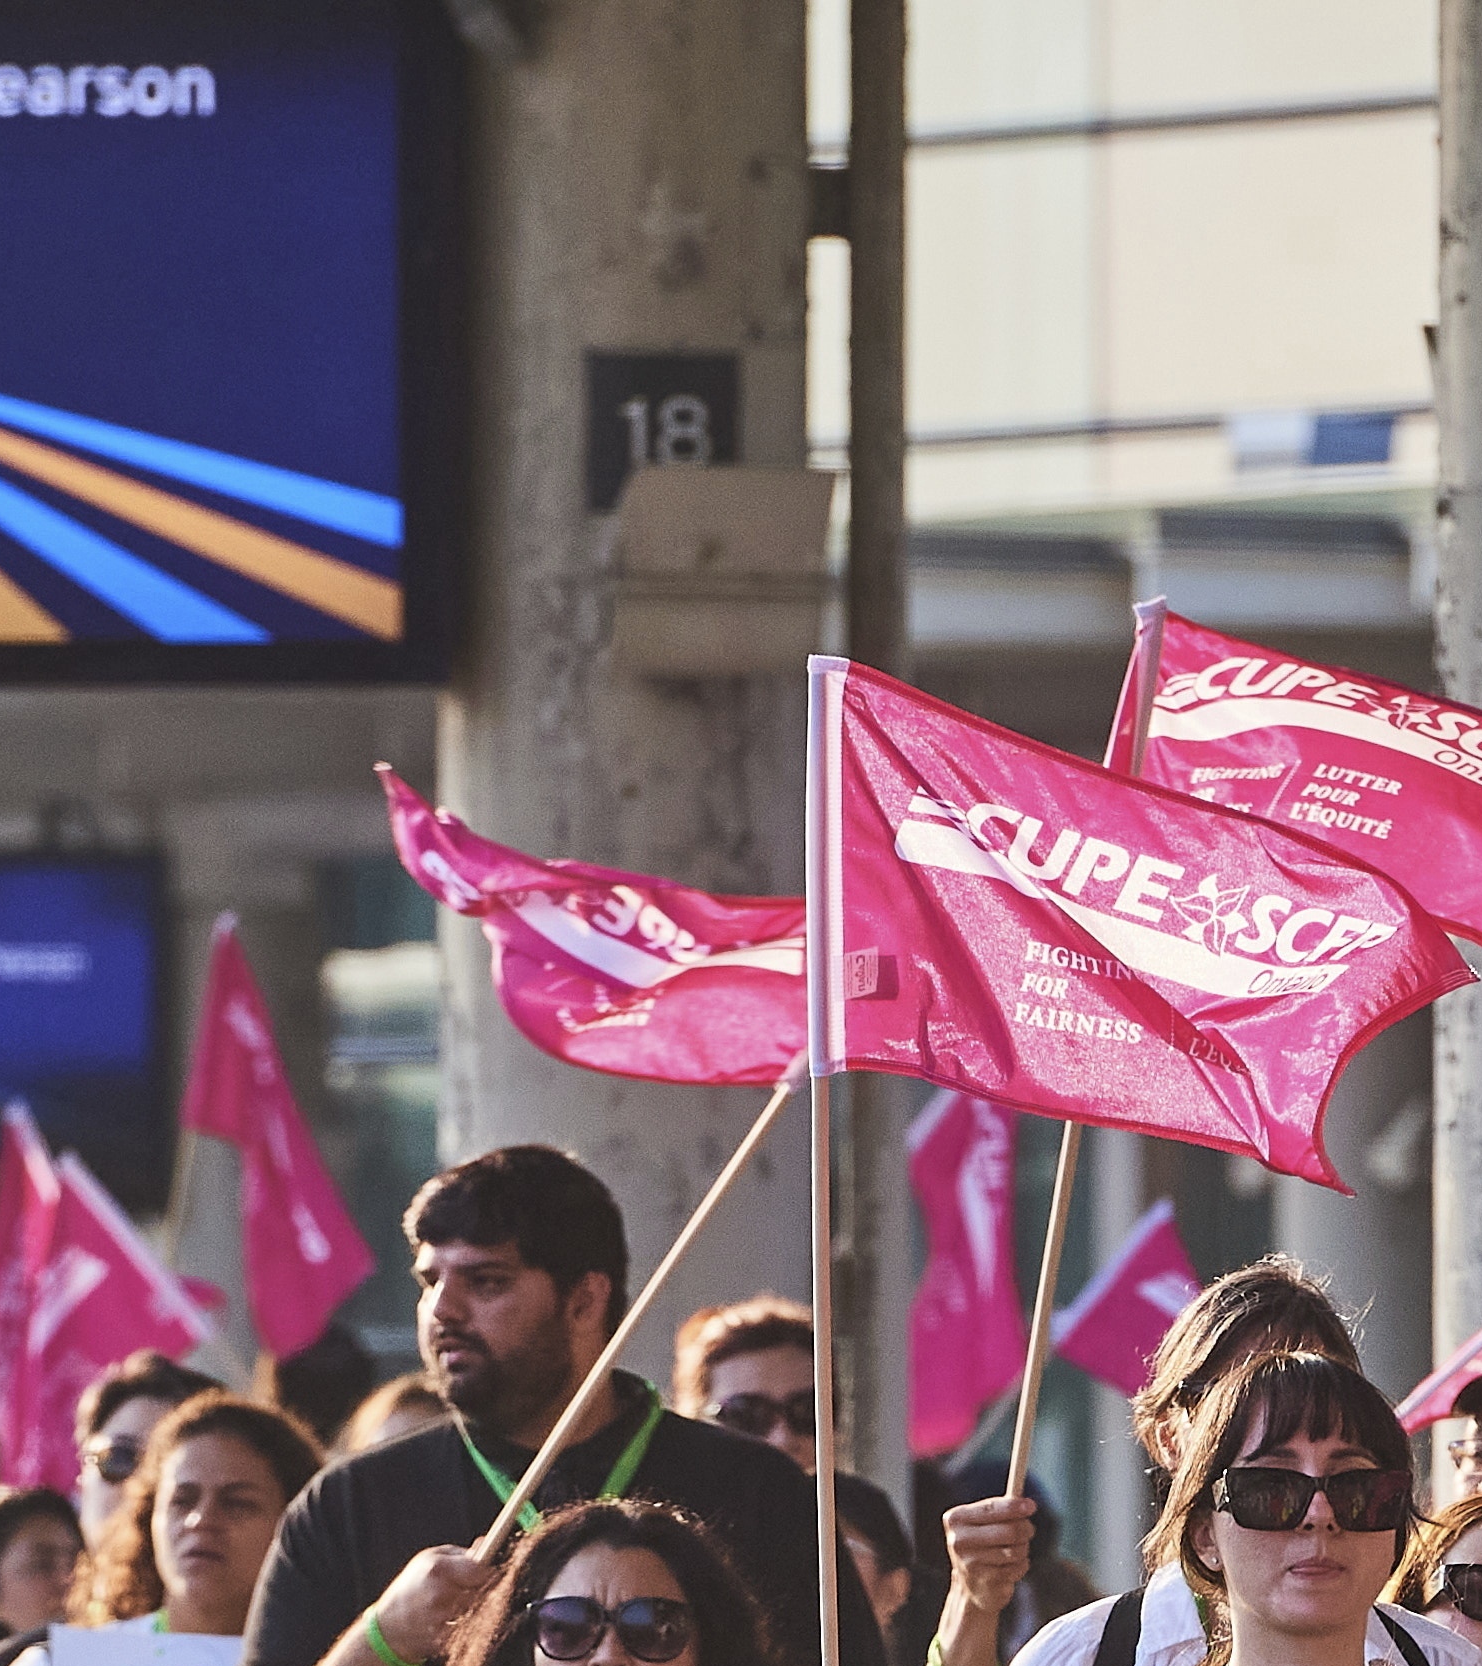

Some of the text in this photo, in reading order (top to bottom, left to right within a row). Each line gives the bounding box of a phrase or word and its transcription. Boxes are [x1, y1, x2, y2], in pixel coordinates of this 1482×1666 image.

[620, 395, 712, 466] 18
[1193, 656, 1377, 710] CUPE
[1189, 762, 1287, 785] FIGHTING
[1312, 762, 1404, 797] LUTTER
[1299, 781, 1362, 808] POUR
[1287, 801, 1394, 840] L'ÉQUITÉ
[965, 803, 1405, 966] CUPE SCFP
[1020, 972, 1070, 1000] FOR
[1013, 1001, 1144, 1045] FAIRNESS
